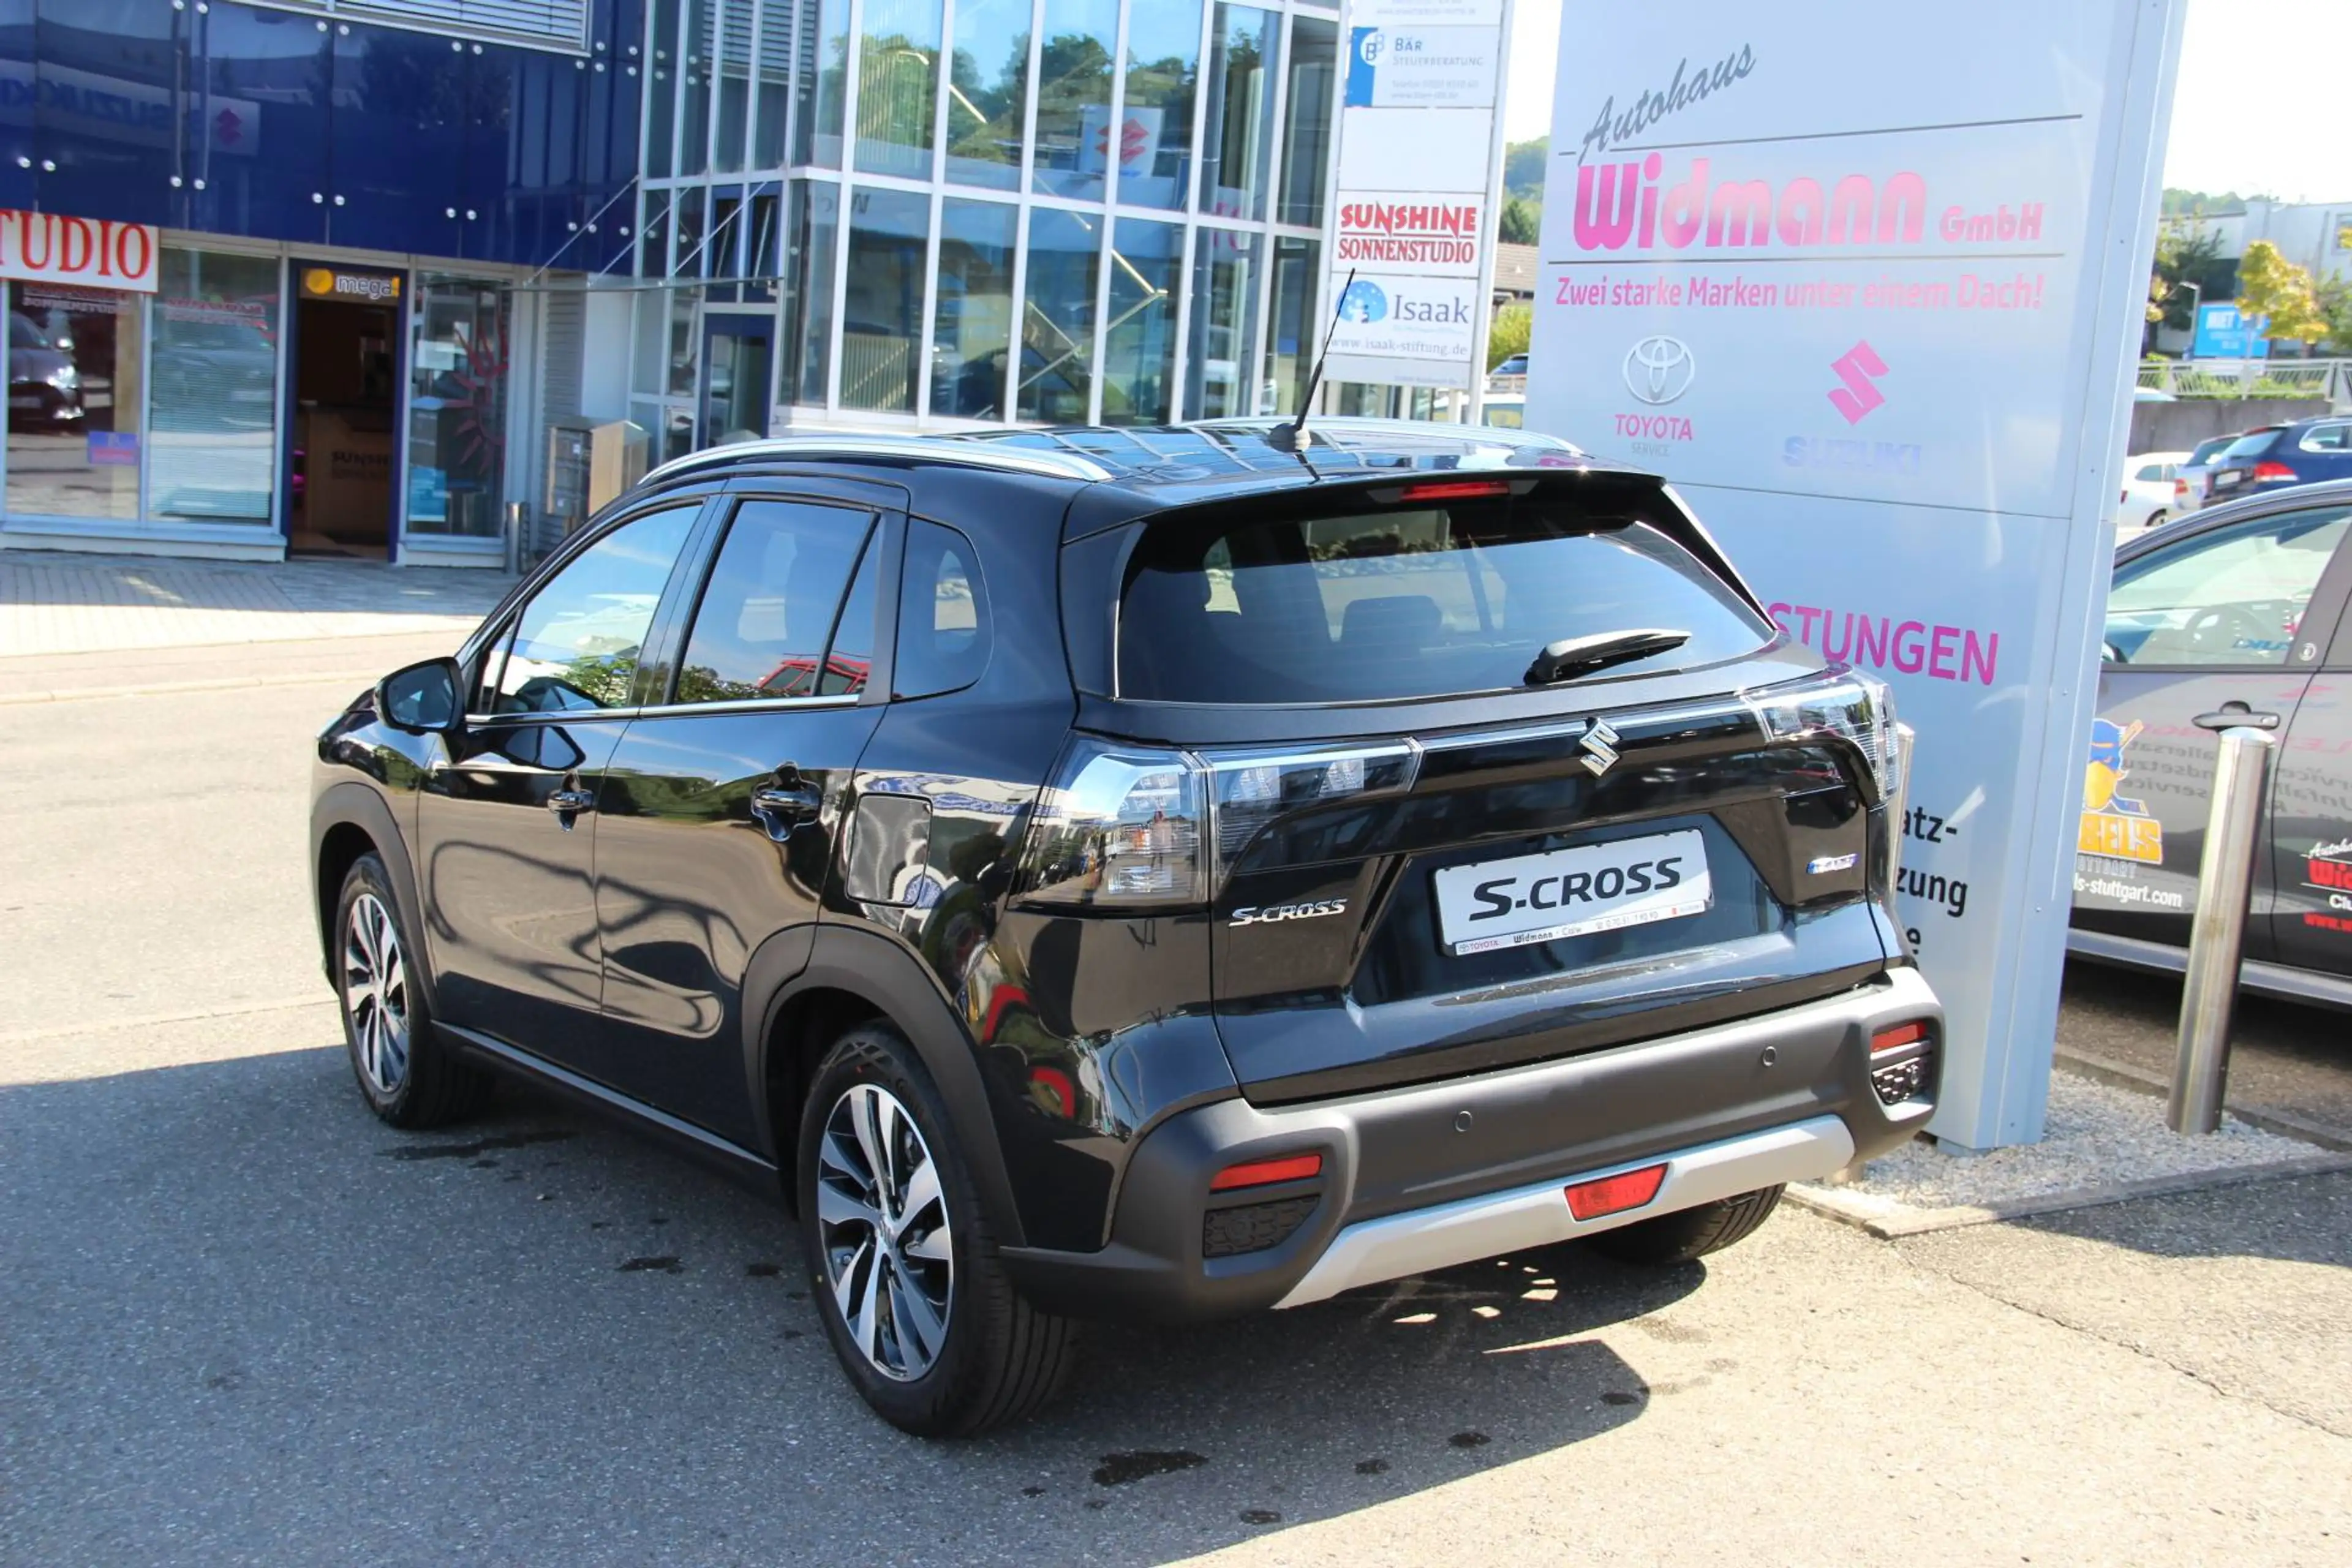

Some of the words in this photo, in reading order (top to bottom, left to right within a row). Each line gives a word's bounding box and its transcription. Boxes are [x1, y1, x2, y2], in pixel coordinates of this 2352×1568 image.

[1577, 43, 1757, 166] Autohaus
[1574, 151, 1927, 251] Widmann
[1939, 202, 2045, 243] GmbH
[1341, 201, 1477, 239] SUNSHINE
[1338, 238, 1474, 263] SONNENSTUDIO
[1392, 294, 1469, 324] Isaak
[1556, 276, 1607, 306] Zwei
[1611, 277, 1682, 306] starke
[1687, 276, 1777, 306] Marken
[1784, 277, 1857, 307] unter
[1863, 274, 1950, 310] einem
[1956, 273, 2046, 310] Dach!
[1330, 337, 1468, 356] www.isaak-stiftung.de
[1615, 414, 1693, 441] TOYOTA
[1631, 442, 1670, 458] SERVICE
[1781, 435, 1922, 475] SUZUKI
[1760, 601, 1999, 686] STUNGEN
[2075, 813, 2162, 864] BELS
[1469, 857, 1683, 921] S-CROSS
[2073, 872, 2182, 907] ls-stuttgart.com
[1229, 898, 1348, 927] S-CROSS
[1469, 940, 1501, 951] TOYOTA
[1513, 932, 1553, 943] Widmann
